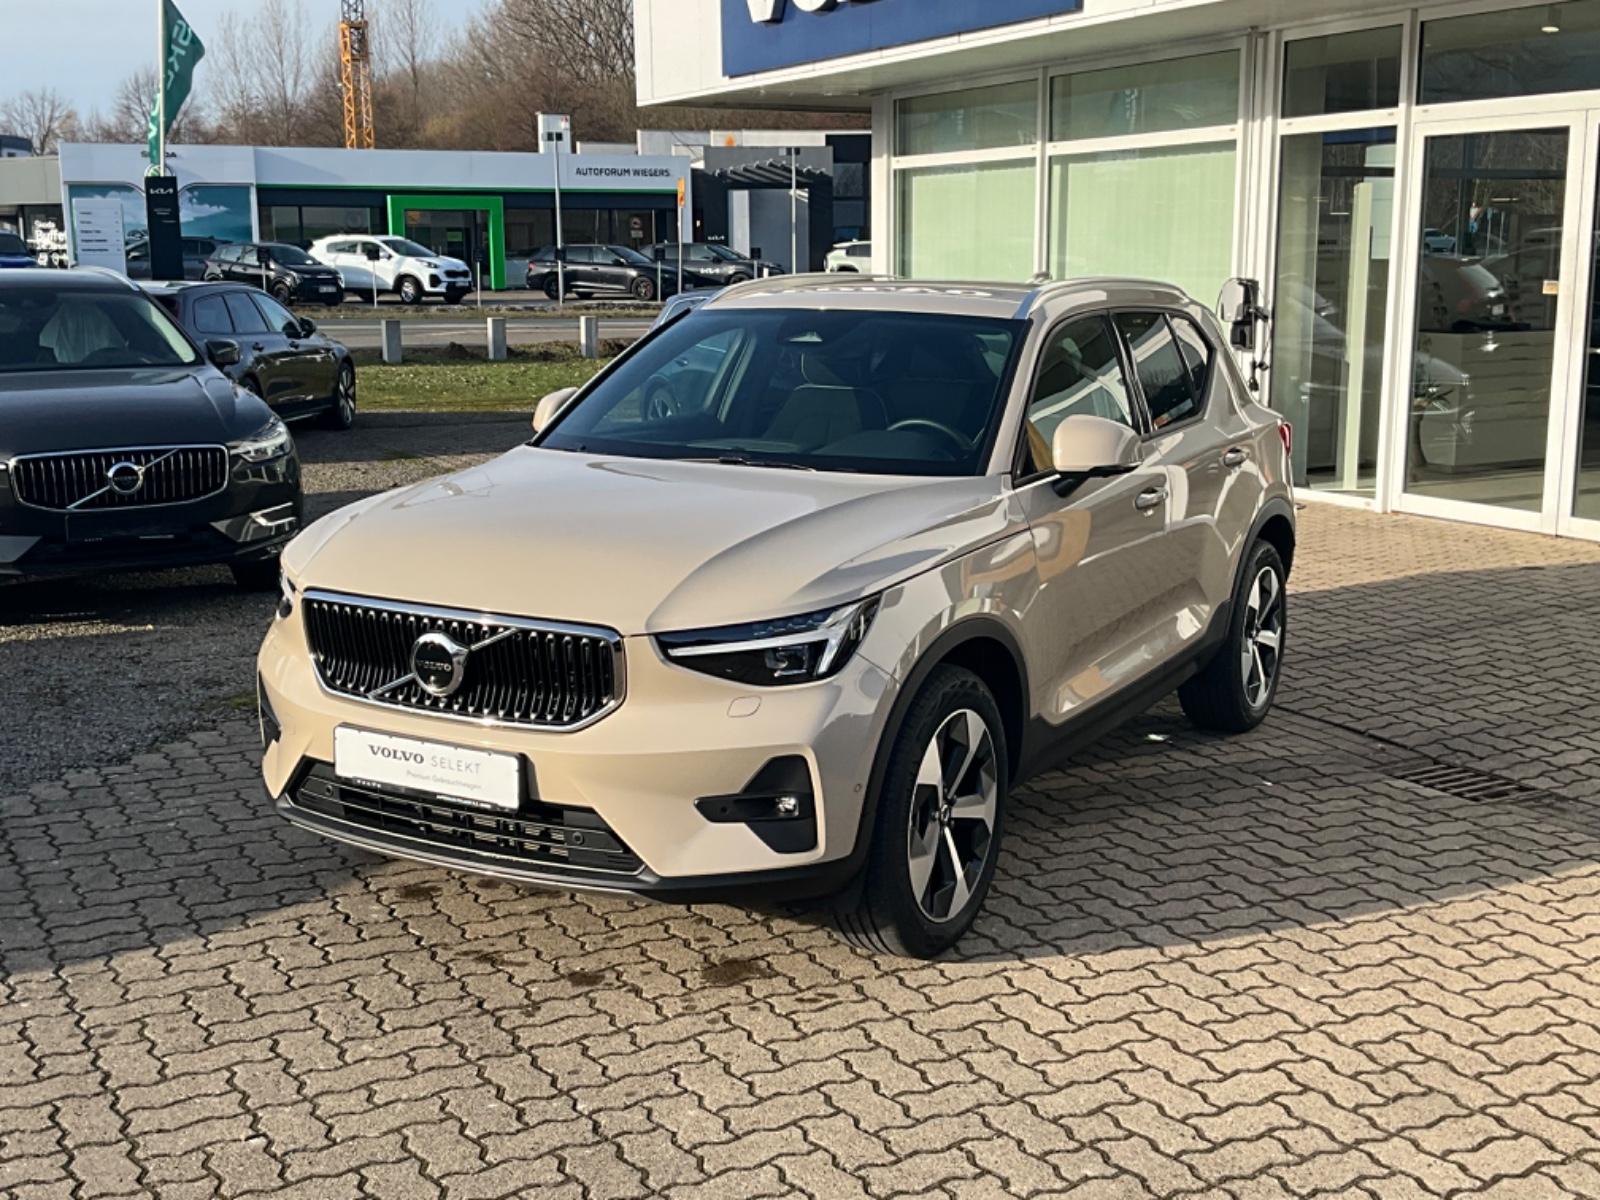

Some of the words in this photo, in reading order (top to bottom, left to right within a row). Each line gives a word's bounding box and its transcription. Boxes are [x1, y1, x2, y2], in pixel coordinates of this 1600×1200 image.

[576, 167, 631, 177] AUTOFORUM
[632, 168, 671, 177] WIEGERS
[368, 744, 425, 764] VOLVO
[431, 755, 481, 774] SELEKT
